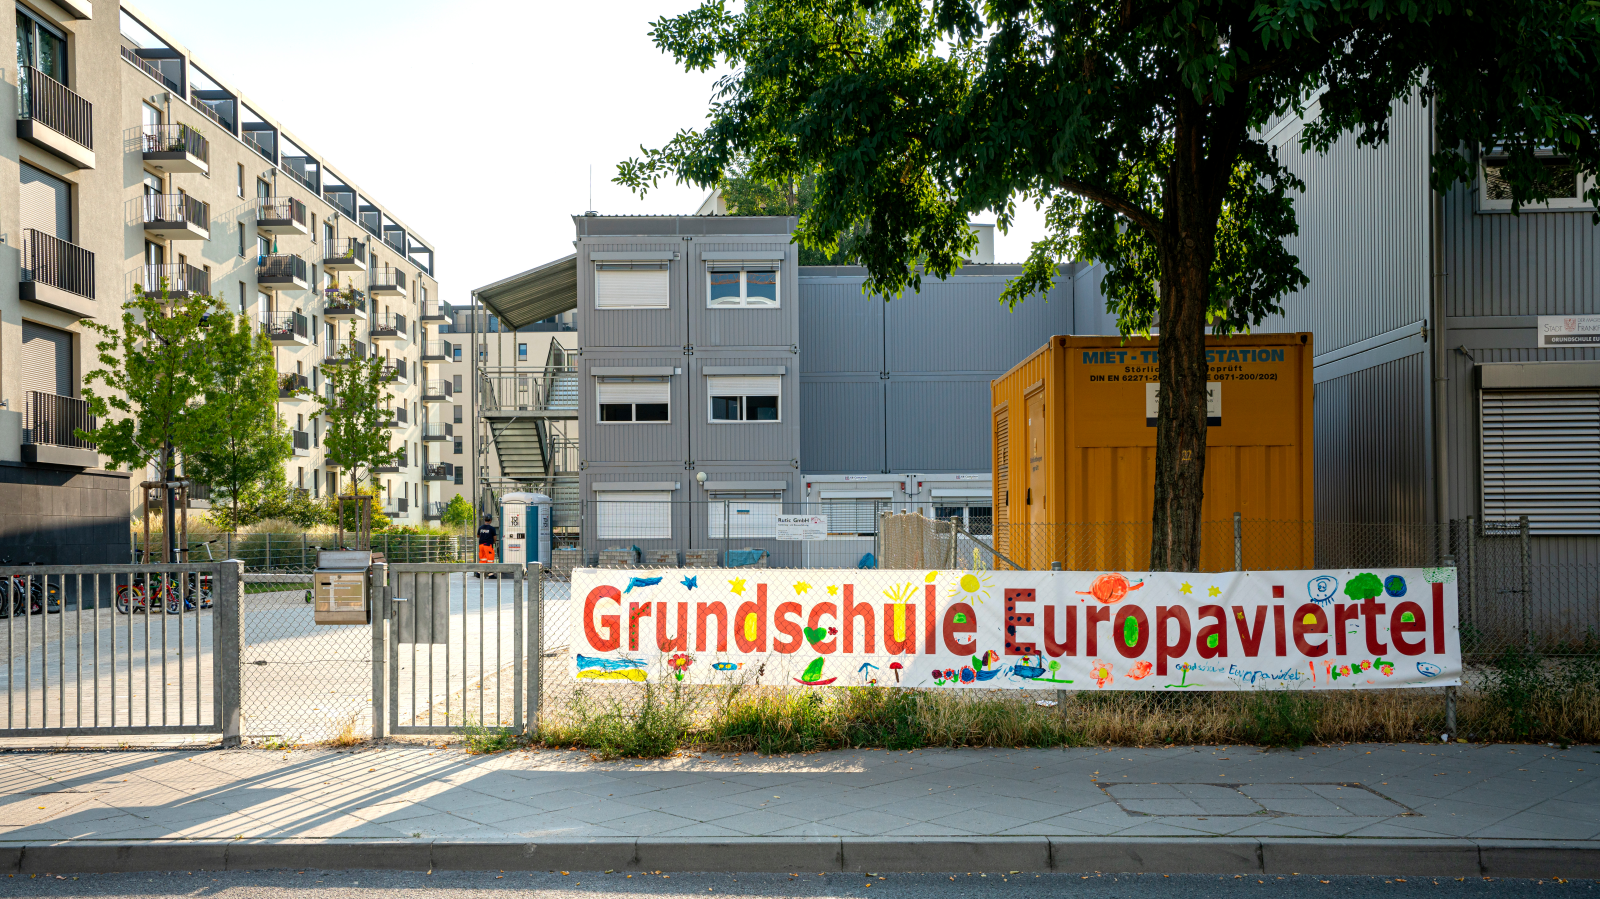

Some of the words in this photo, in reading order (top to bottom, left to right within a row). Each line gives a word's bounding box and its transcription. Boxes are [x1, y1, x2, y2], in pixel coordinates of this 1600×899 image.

[1578, 323, 1600, 331] FRANKF
[1122, 374, 1159, 382] 62271-2
[583, 583, 977, 656] Grundschule
[1004, 582, 1446, 676] Europaviertel
